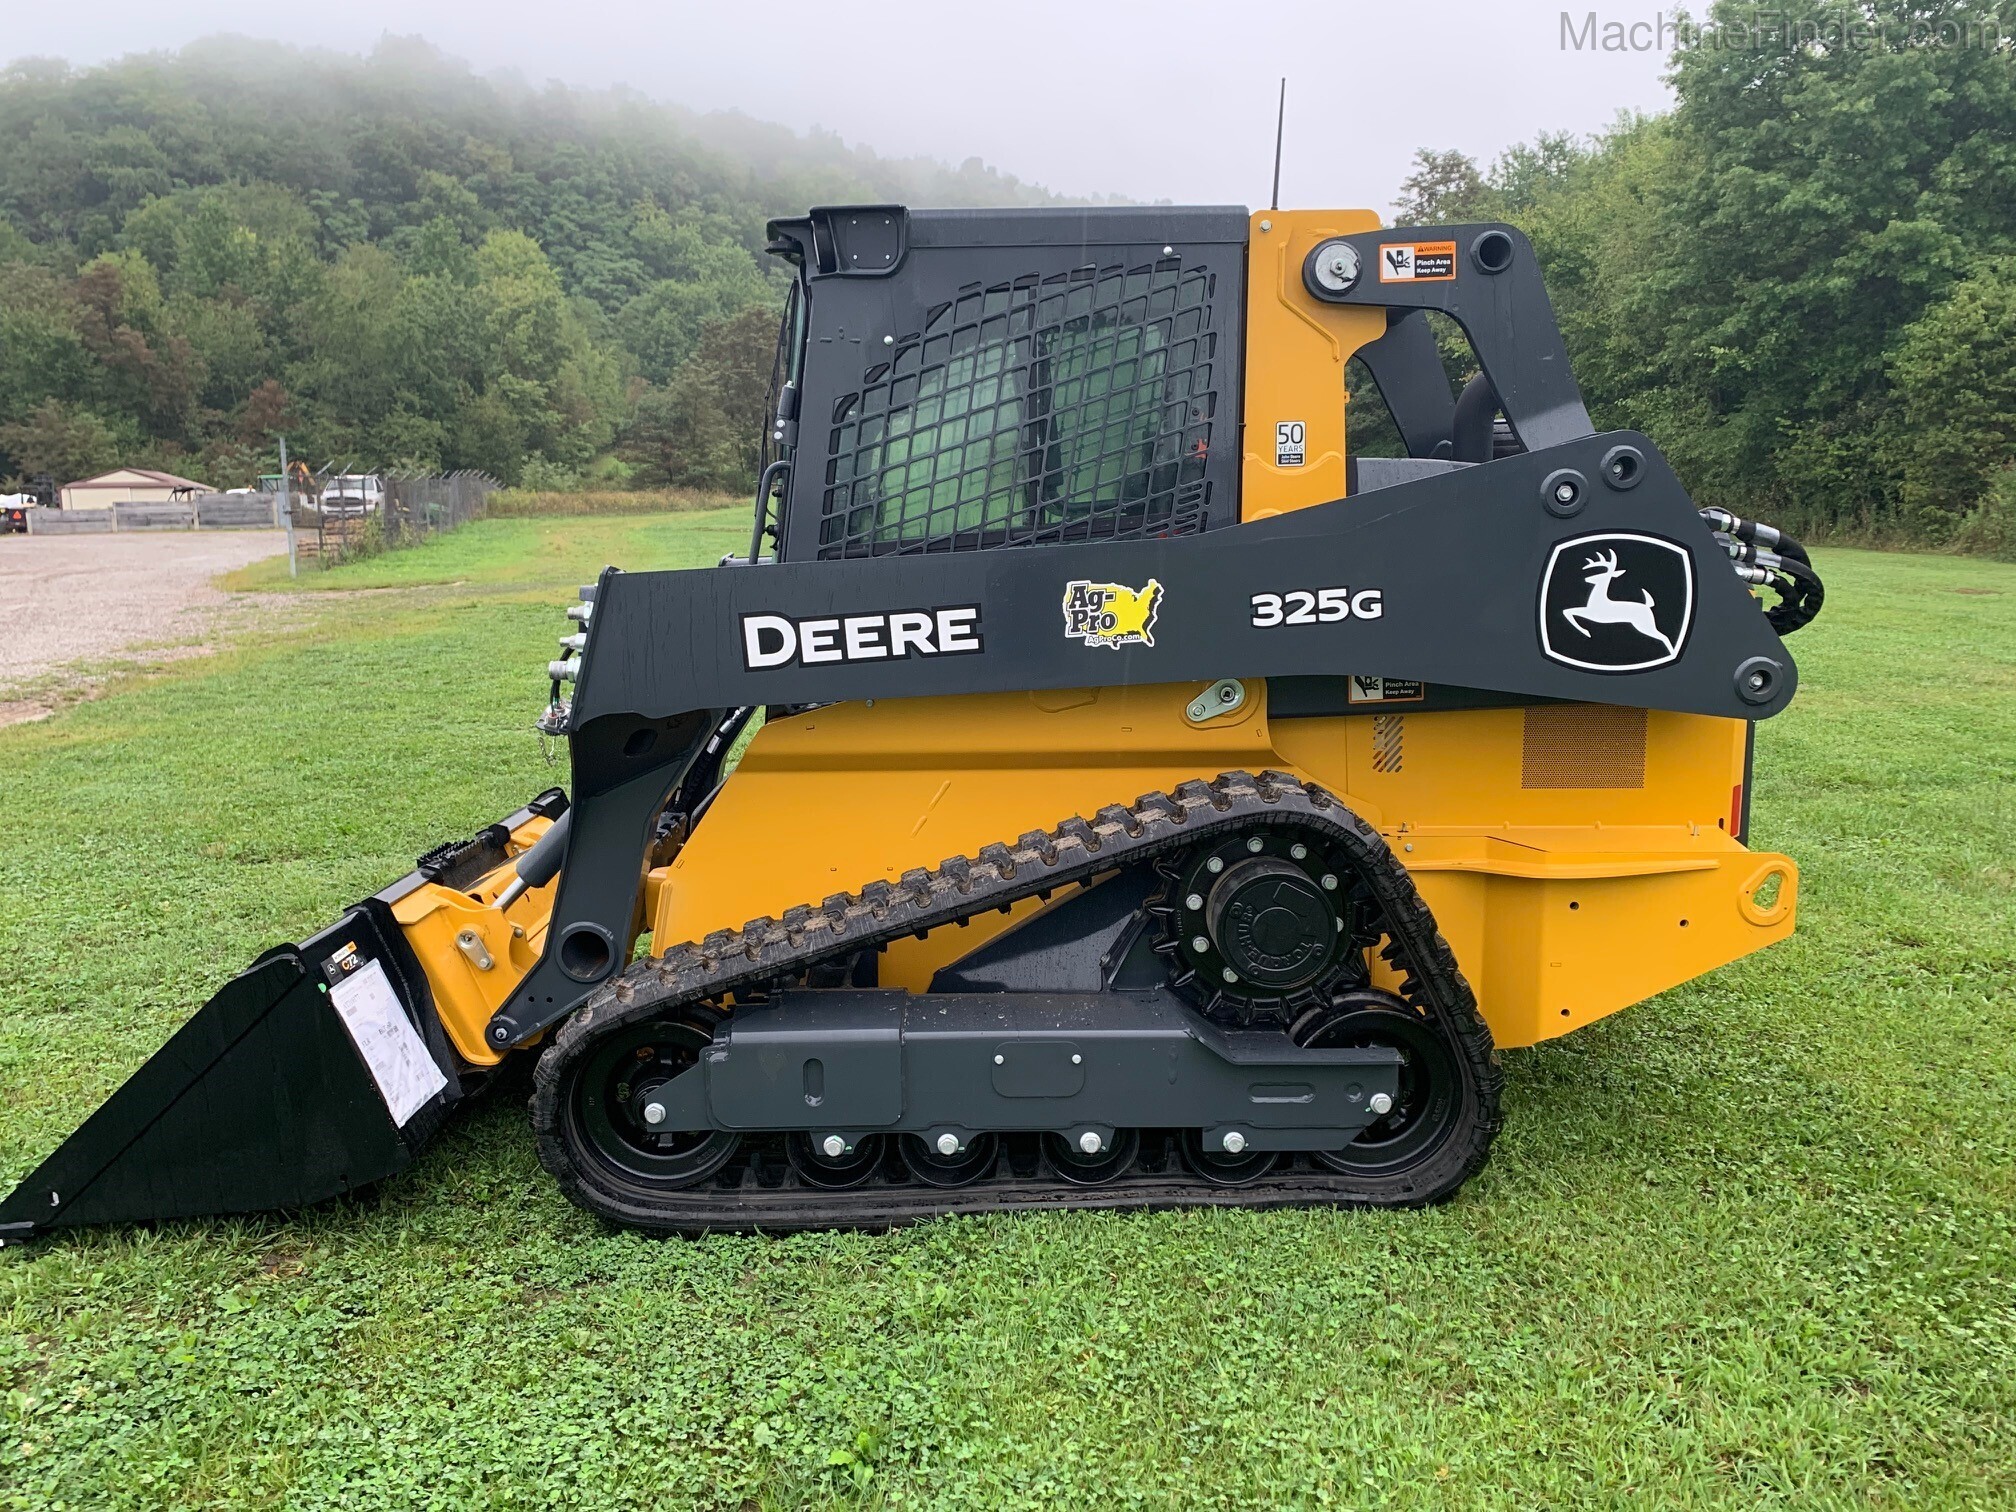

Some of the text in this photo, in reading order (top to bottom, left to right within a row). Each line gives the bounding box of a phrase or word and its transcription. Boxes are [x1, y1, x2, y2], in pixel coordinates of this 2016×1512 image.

[1278, 424, 1304, 445] 50
[1278, 445, 1304, 453] YEARS
[1069, 586, 1114, 612] Ag-
[1252, 589, 1383, 628] 325G
[1070, 609, 1116, 633] Pro
[743, 608, 980, 668] DEERE
[1088, 634, 1140, 645] AgProCo.com
[341, 953, 359, 971] C72
